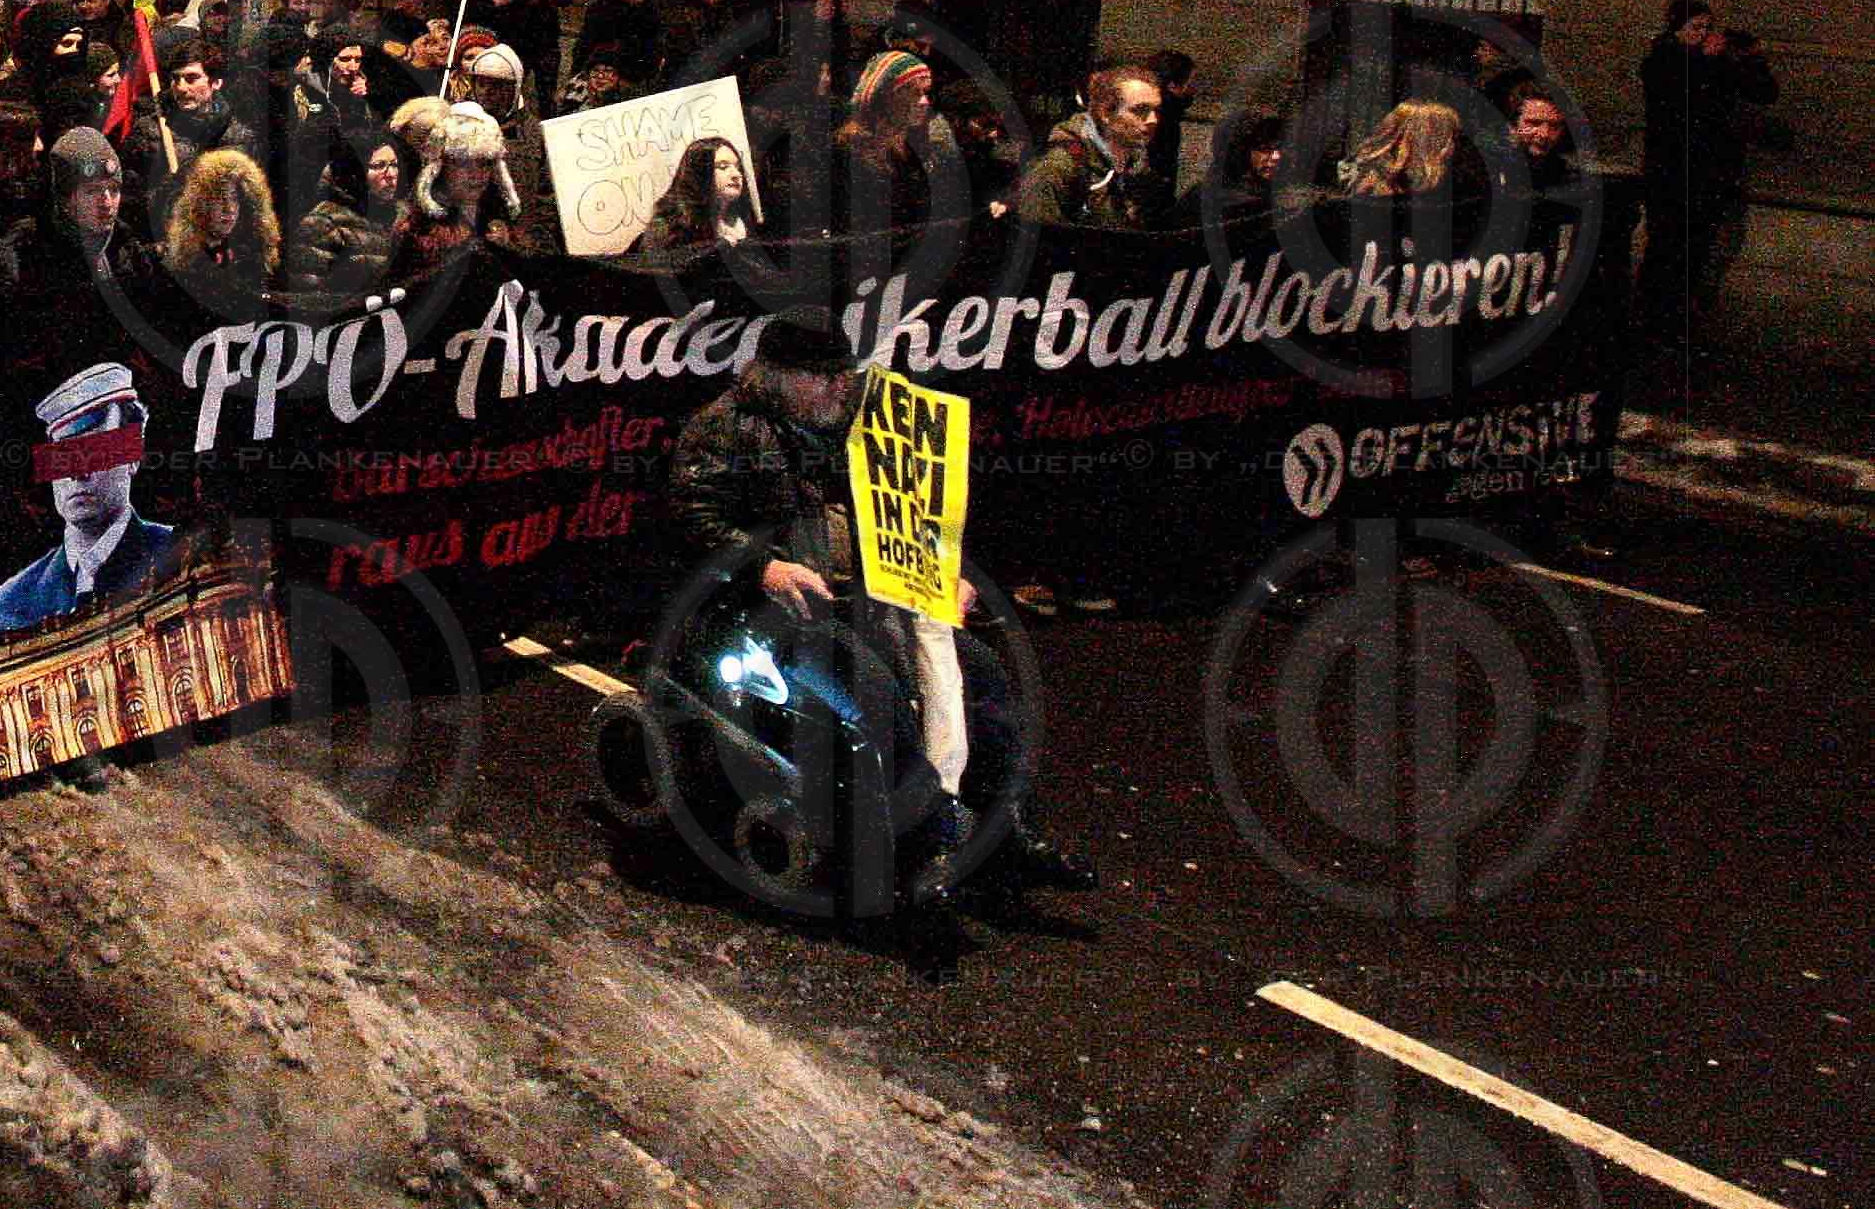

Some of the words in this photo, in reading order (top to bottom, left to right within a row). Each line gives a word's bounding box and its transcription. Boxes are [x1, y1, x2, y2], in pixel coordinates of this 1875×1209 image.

[575, 94, 721, 171] SHAME
[182, 264, 1213, 453] FPÖ-Akadeikerball
[1205, 223, 1574, 351] blockieren!
[871, 489, 905, 537] IN
